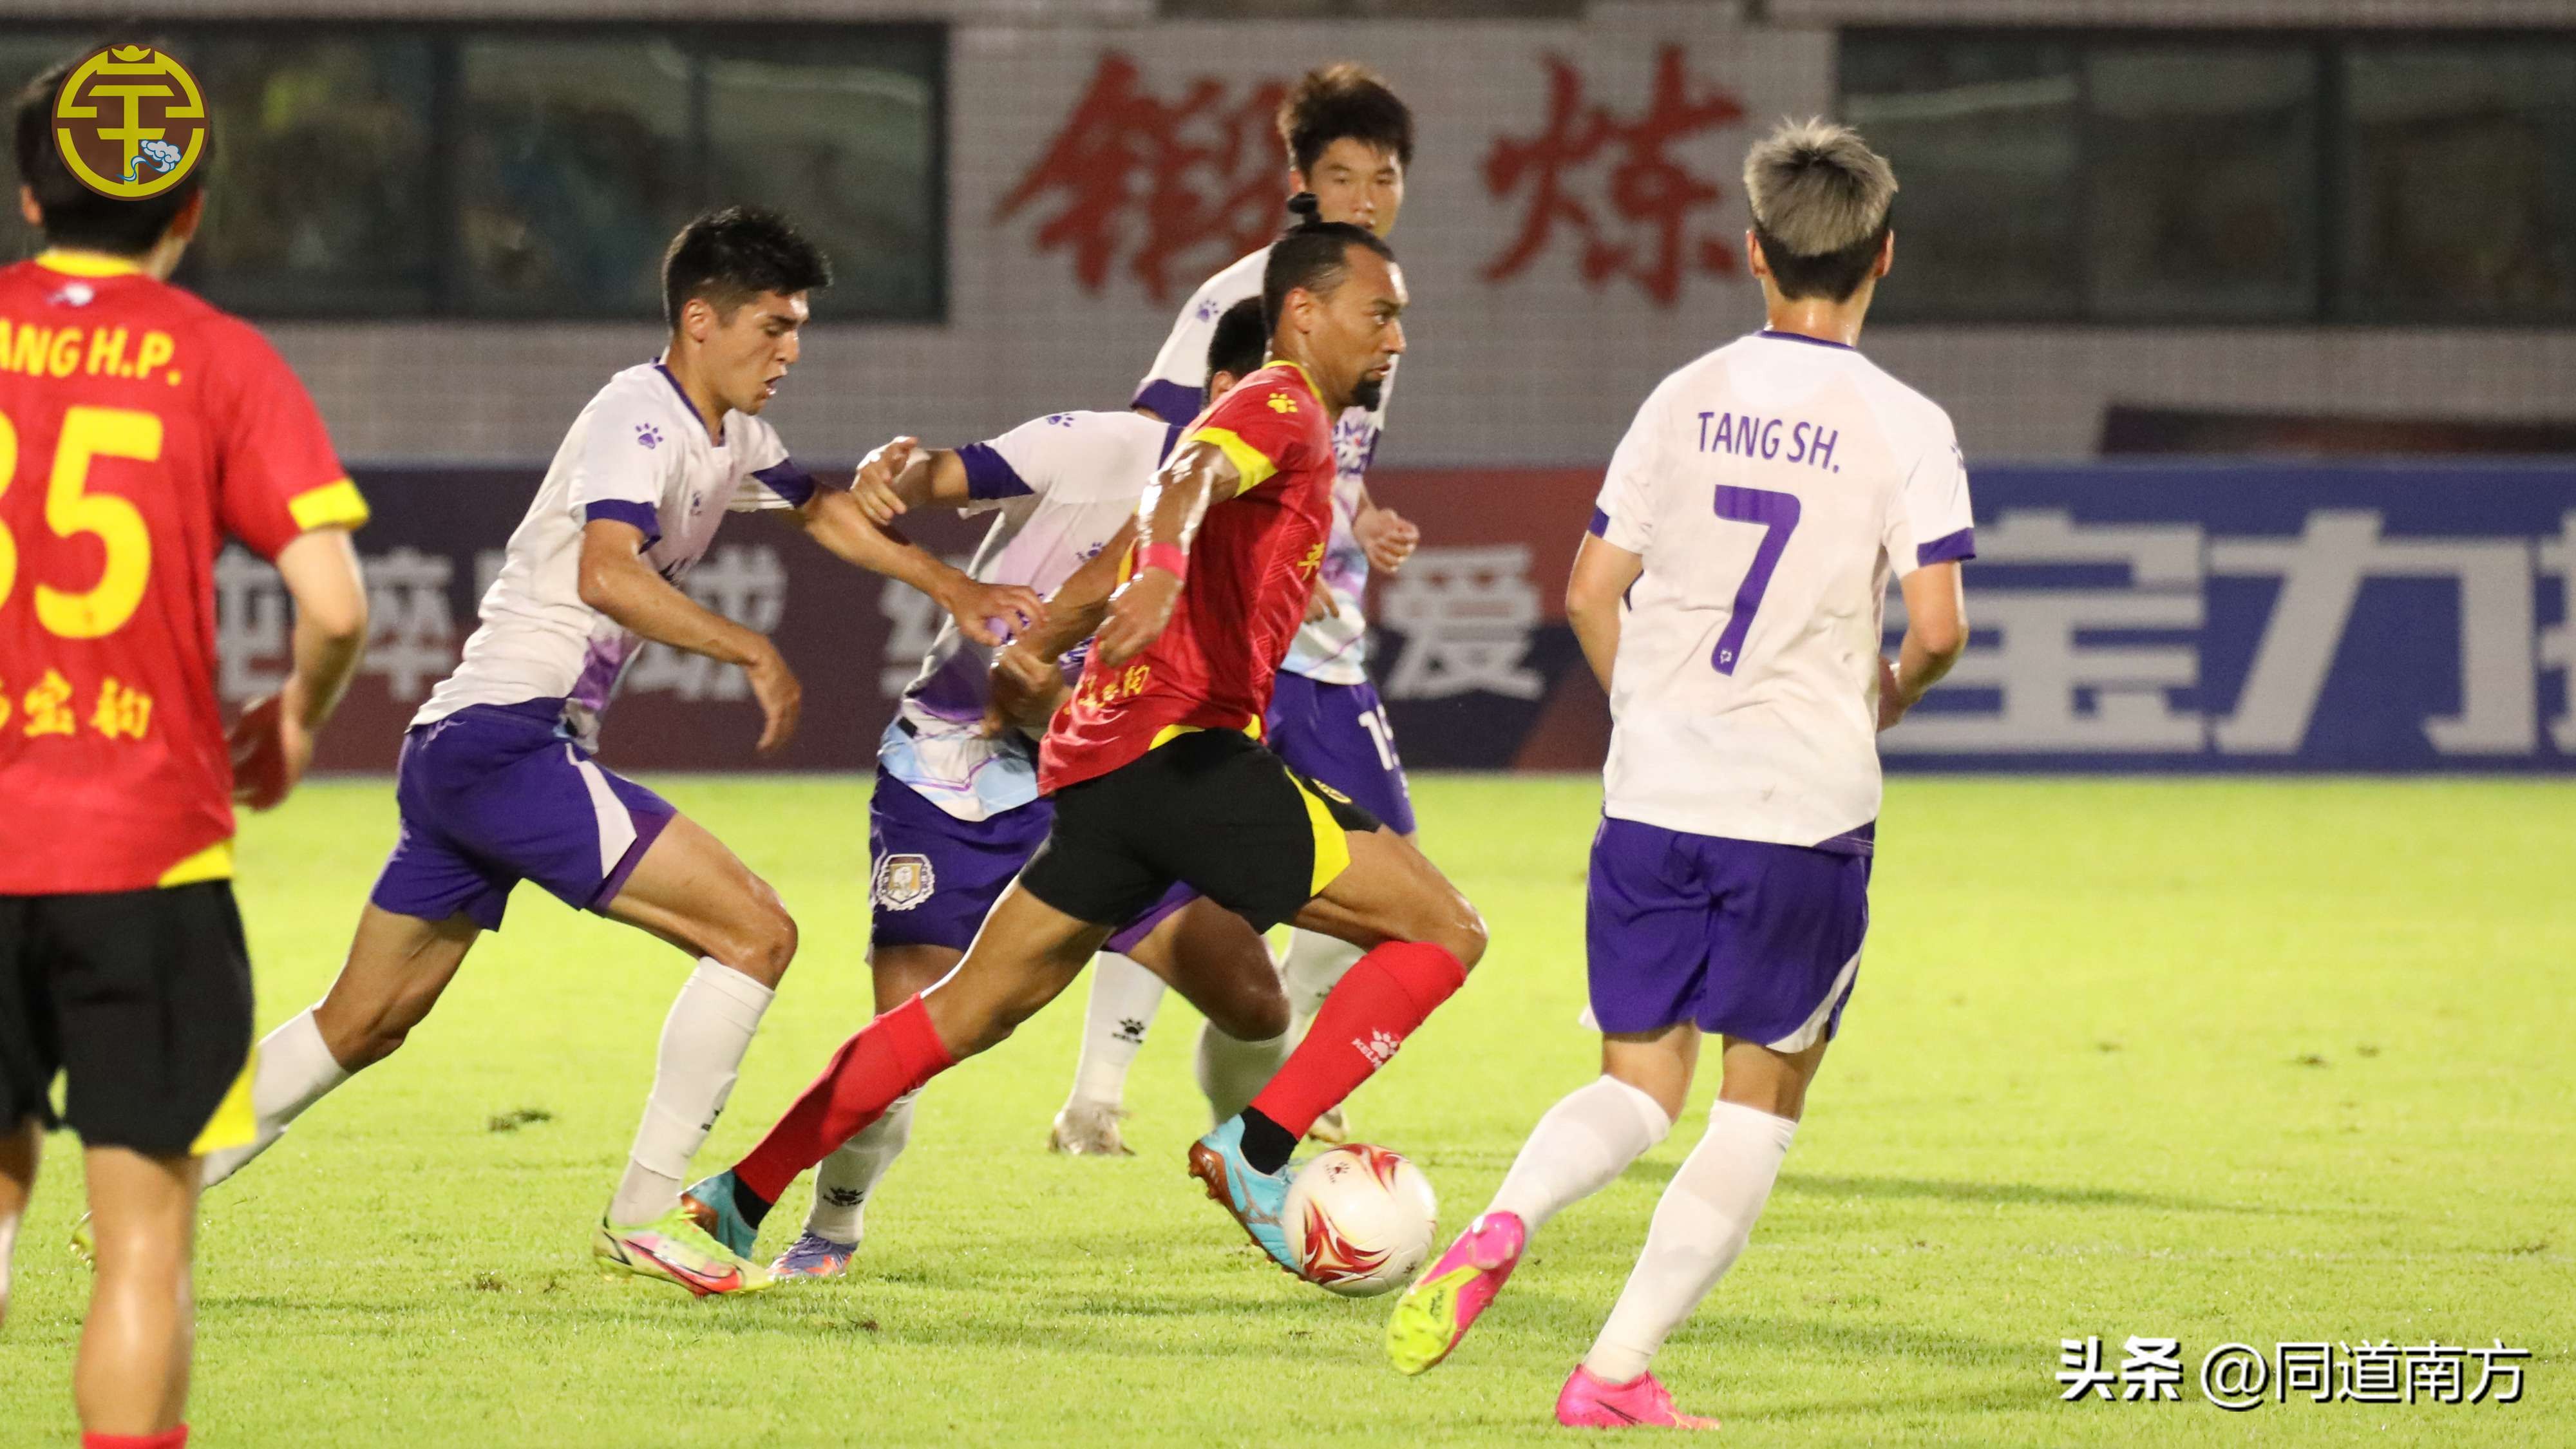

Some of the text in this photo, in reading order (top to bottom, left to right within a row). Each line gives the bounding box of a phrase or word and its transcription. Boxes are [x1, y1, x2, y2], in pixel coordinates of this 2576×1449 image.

[85, 325, 181, 387] H.P.
[1697, 411, 1840, 474] TANG SH.
[0, 405, 164, 639] 5
[1711, 484, 1801, 677] 7
[1358, 703, 1401, 771] 1
